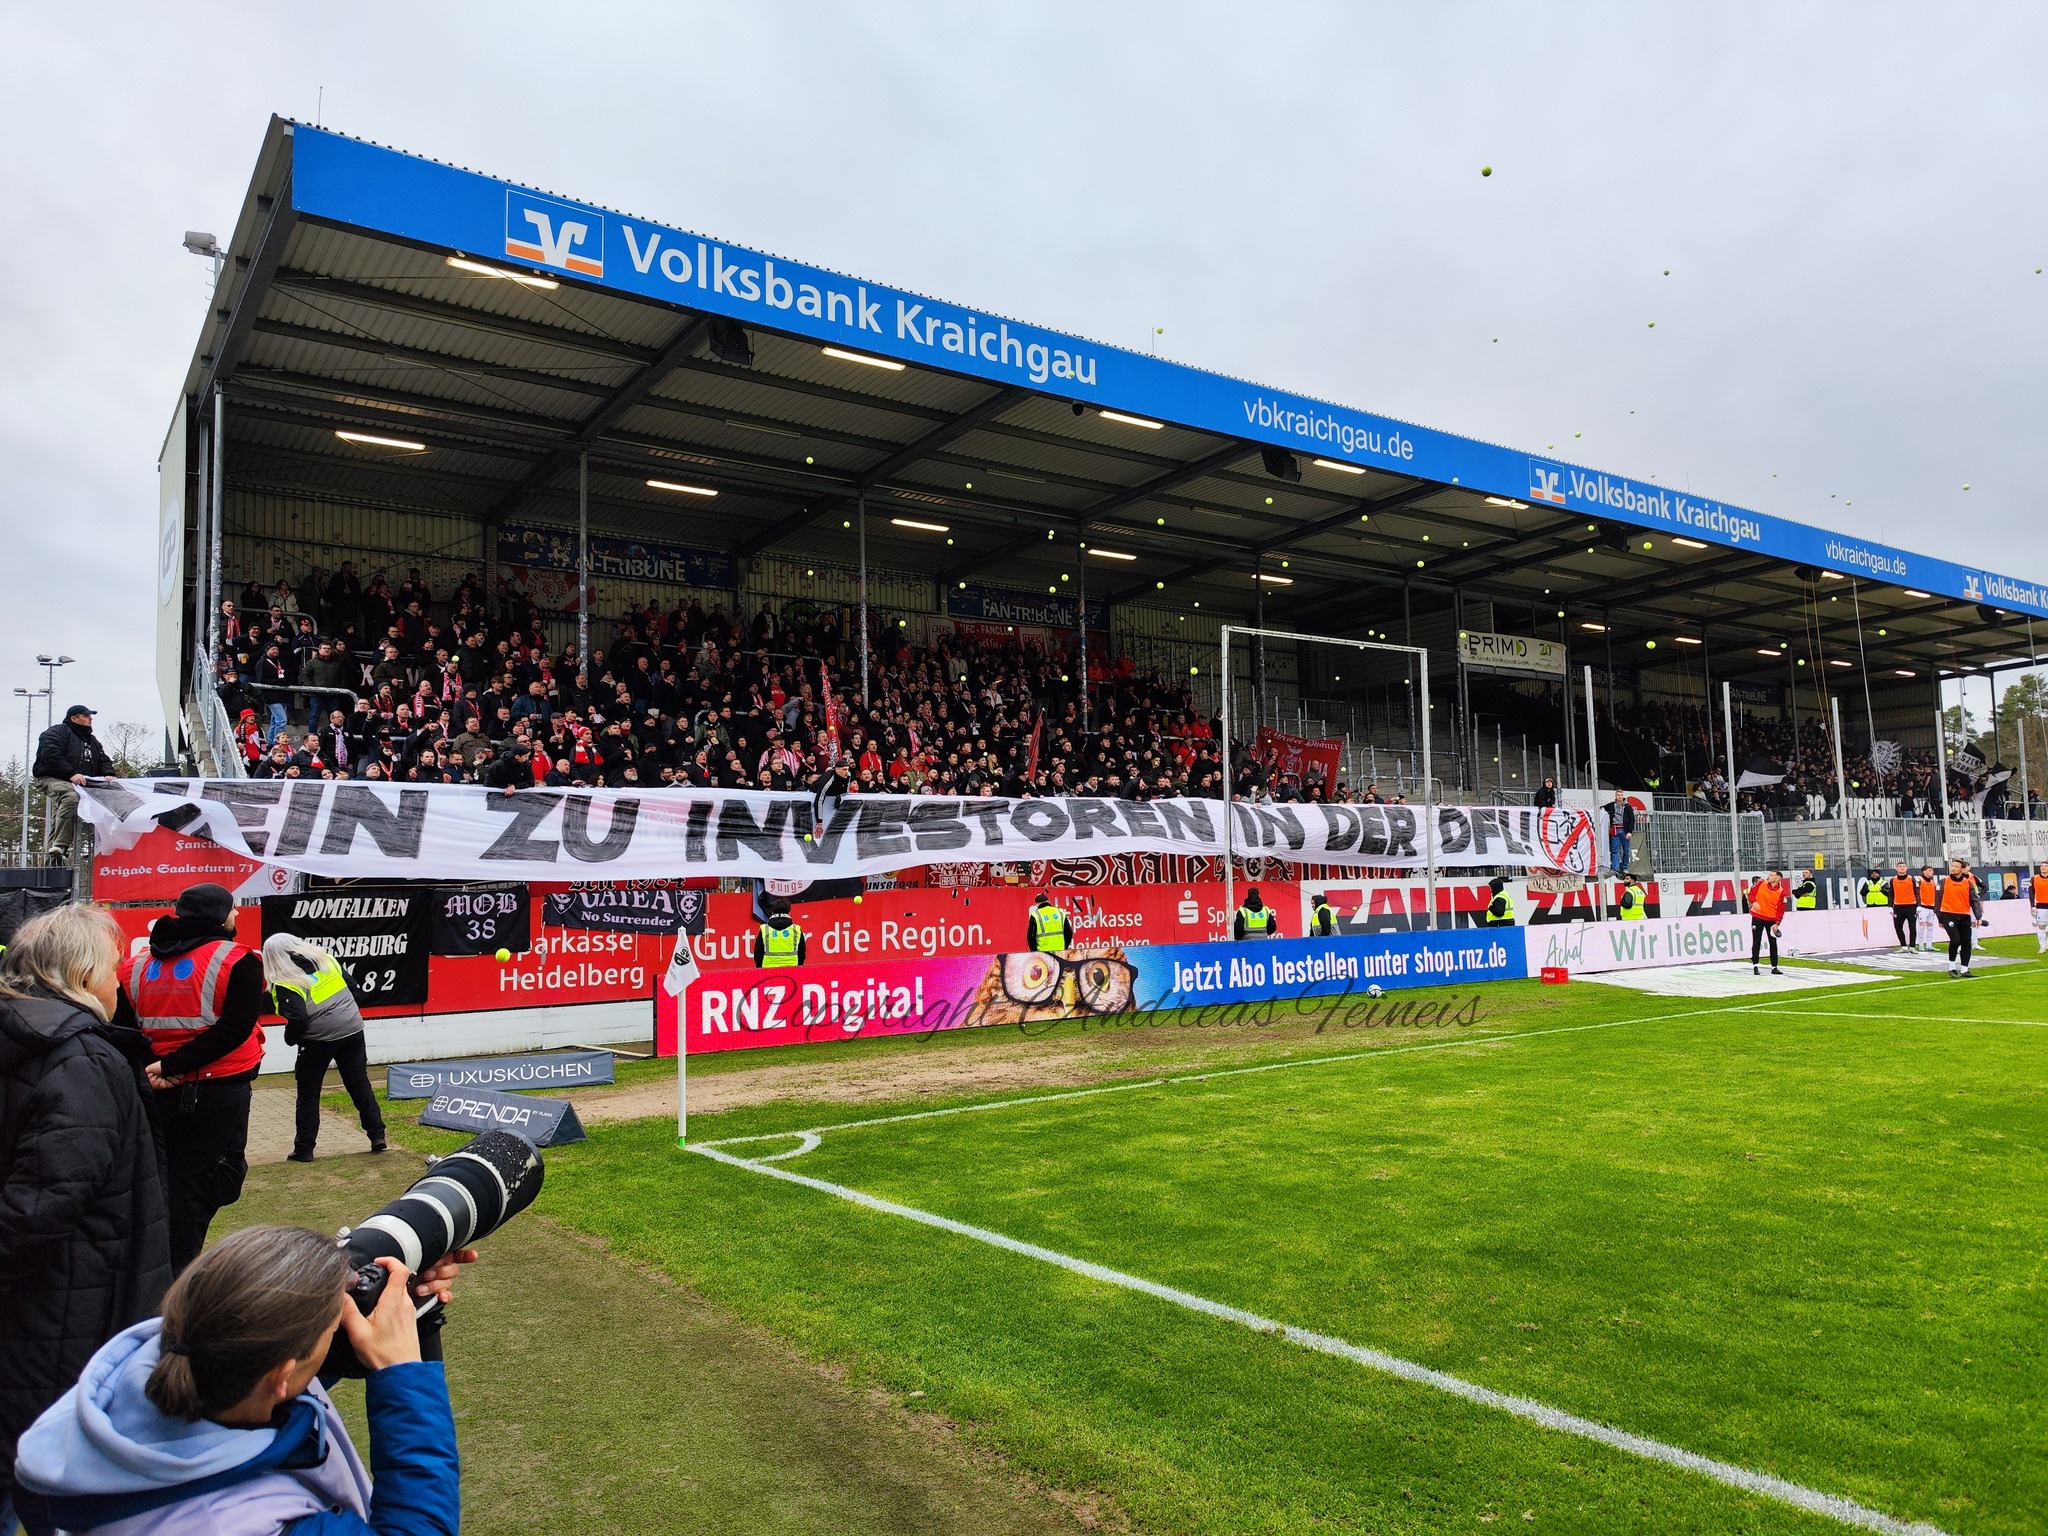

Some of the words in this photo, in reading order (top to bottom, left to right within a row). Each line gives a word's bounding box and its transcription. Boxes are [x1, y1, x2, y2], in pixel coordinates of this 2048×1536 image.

[622, 224, 882, 334] Volksbank
[896, 299, 1097, 387] Kraichgau
[1243, 398, 1414, 462] vbkraichgau.de
[1570, 469, 1671, 521] Volksbank
[1674, 497, 1761, 543] Kraichgau
[1825, 540, 1907, 577] vbkraichgau.de
[1984, 575, 2040, 608] Volksbank
[479, 791, 641, 863] ZU
[686, 799, 1216, 864] INVESTOREN
[1232, 803, 1306, 850] IN
[1317, 804, 1418, 857] DER
[1438, 808, 1535, 858] DFL!
[99, 866, 153, 878] Brigade
[239, 863, 254, 874] 71
[291, 897, 410, 919] DOMFALKEN
[581, 910, 599, 922] No
[602, 912, 674, 927] Surrender
[466, 918, 496, 940] 38
[517, 929, 633, 962] parkasse
[822, 921, 871, 954] die
[881, 920, 993, 957] Region.
[1609, 924, 1658, 962] Wir
[1667, 921, 1745, 958] lieben
[500, 962, 645, 992] Heidelberg
[1173, 960, 1224, 994] Jetzt
[1229, 956, 1267, 988] Abo
[1272, 952, 1359, 985] bestellen
[1363, 950, 1411, 979] unter
[1414, 942, 1508, 978] shop.rnz.de
[702, 985, 786, 1035] RNZ
[801, 976, 924, 1033] Digital
[438, 1061, 592, 1086] LUXUSKÜCHEN
[446, 1096, 532, 1127] ORENDA
